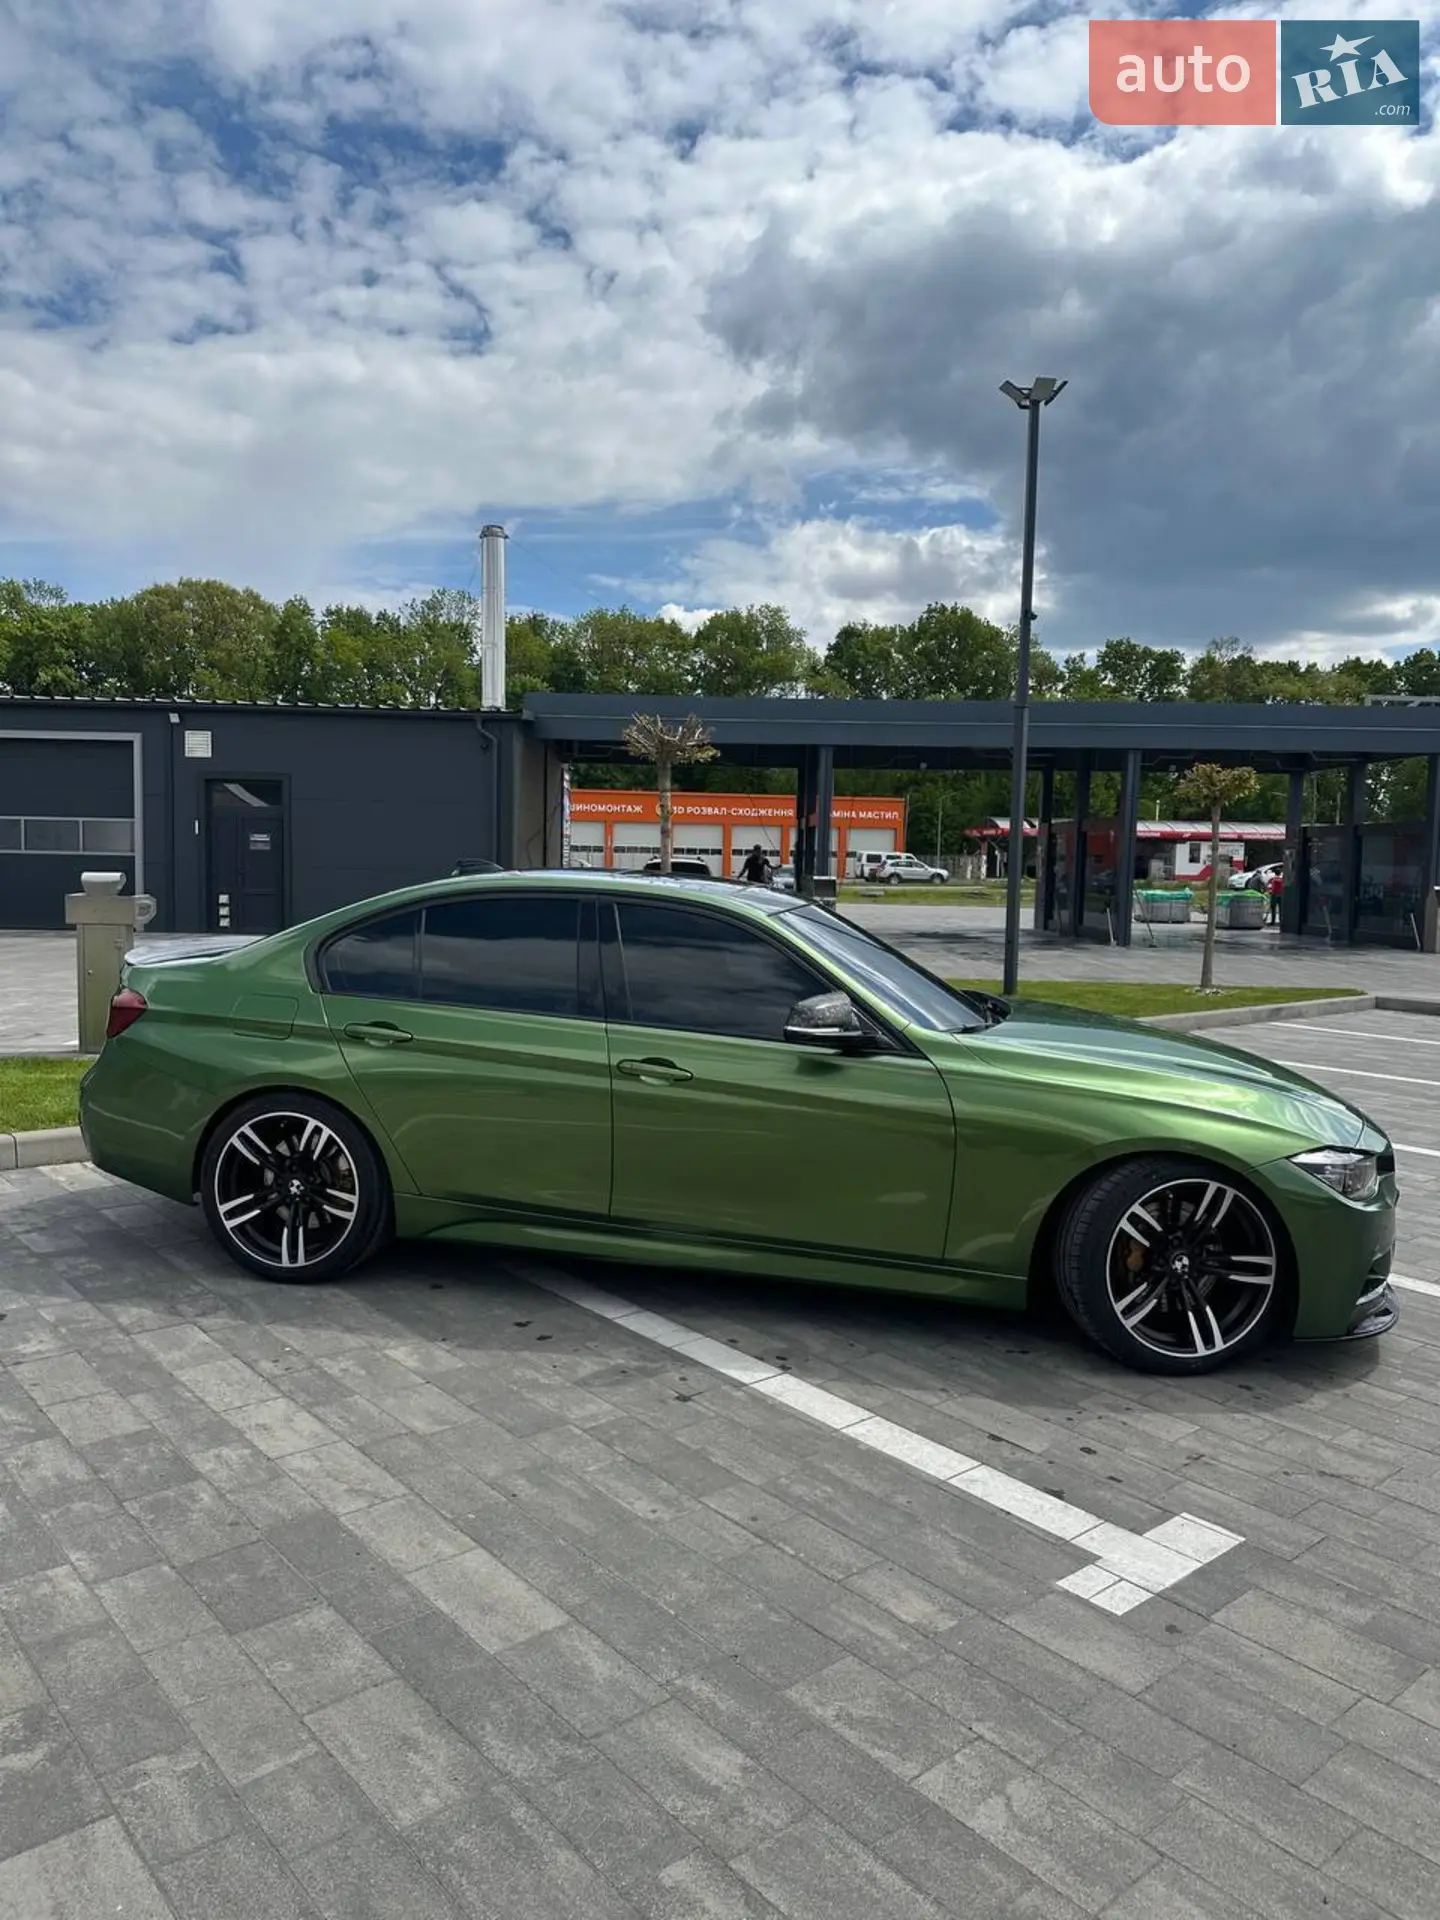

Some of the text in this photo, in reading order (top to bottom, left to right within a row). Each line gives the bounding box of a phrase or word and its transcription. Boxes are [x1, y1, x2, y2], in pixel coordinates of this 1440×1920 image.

[686, 806, 794, 817] РОЗВАЛ-СХОДЖЕННЯ
[830, 810, 900, 820] МІНА МАСТИЛ
